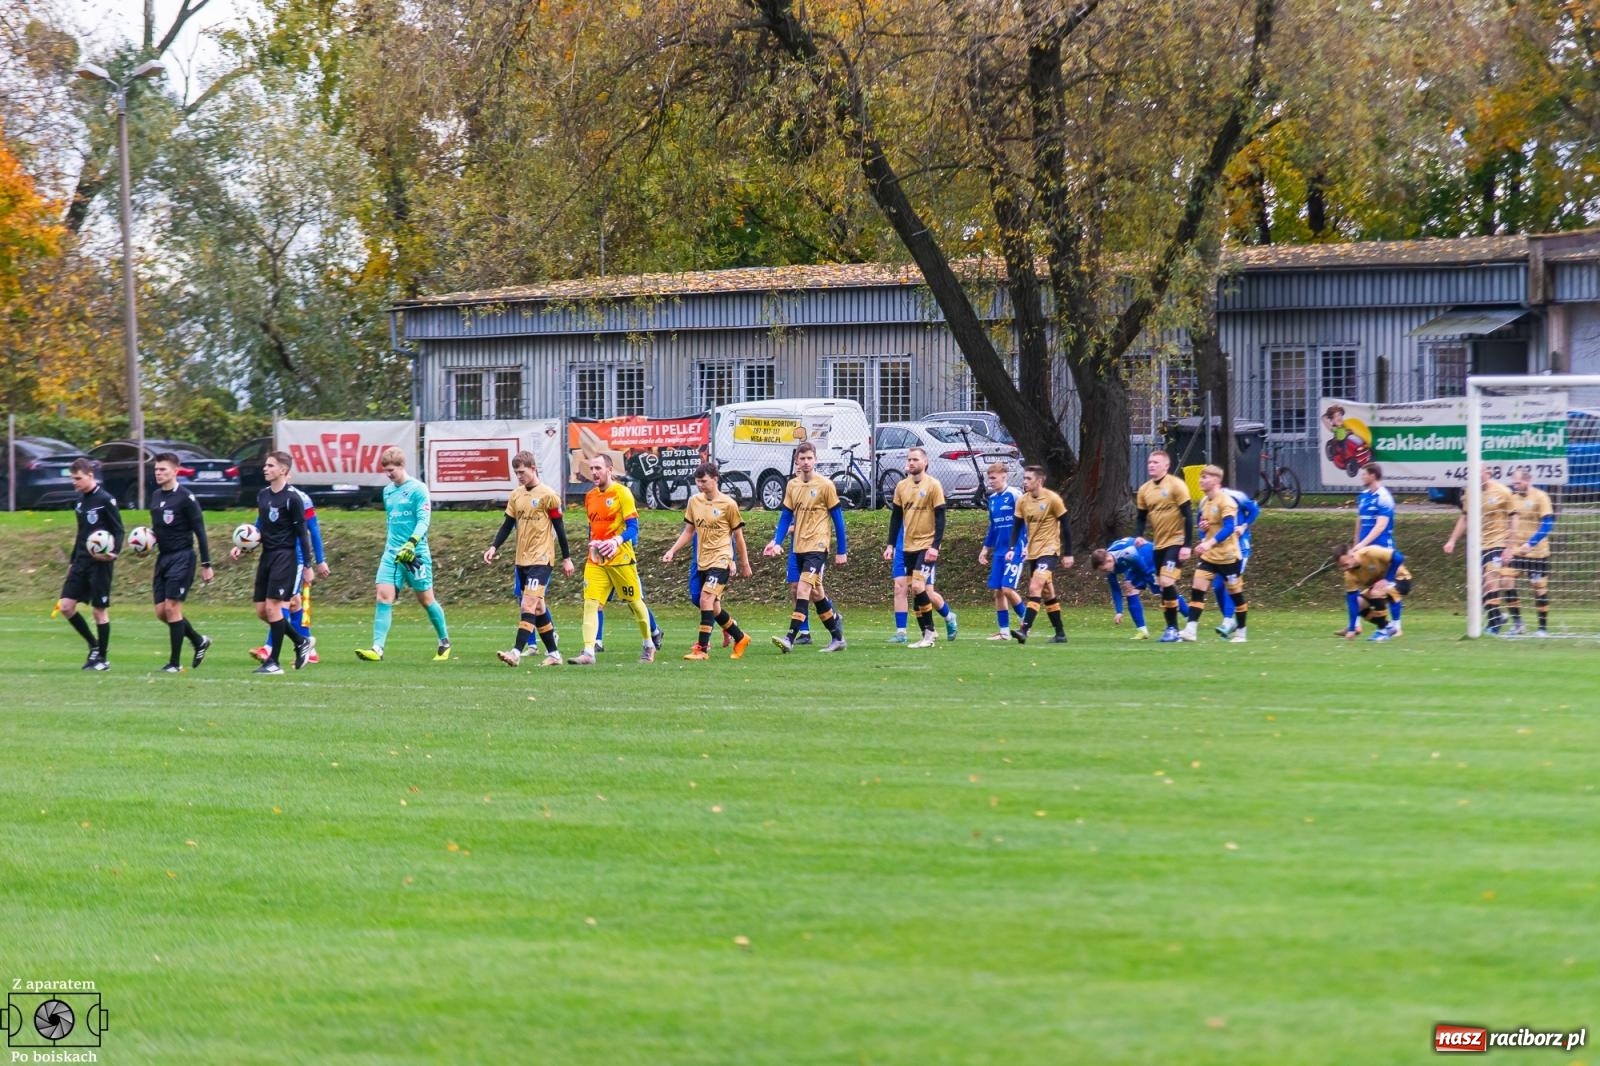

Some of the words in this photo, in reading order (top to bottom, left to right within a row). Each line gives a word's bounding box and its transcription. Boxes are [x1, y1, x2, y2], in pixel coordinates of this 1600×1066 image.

[611, 425, 653, 438] BRYKIET
[656, 425, 660, 436] I
[662, 423, 703, 436] PELLET
[1375, 427, 1565, 454] zakladamyrawniki.pl
[661, 450, 674, 458] 537
[674, 450, 686, 458] 573
[662, 459, 676, 467] 600
[663, 469, 677, 477] 604
[1536, 464, 1563, 478] 735
[1003, 563, 1019, 577] 79
[527, 578, 540, 591] 10
[708, 576, 719, 589] 21
